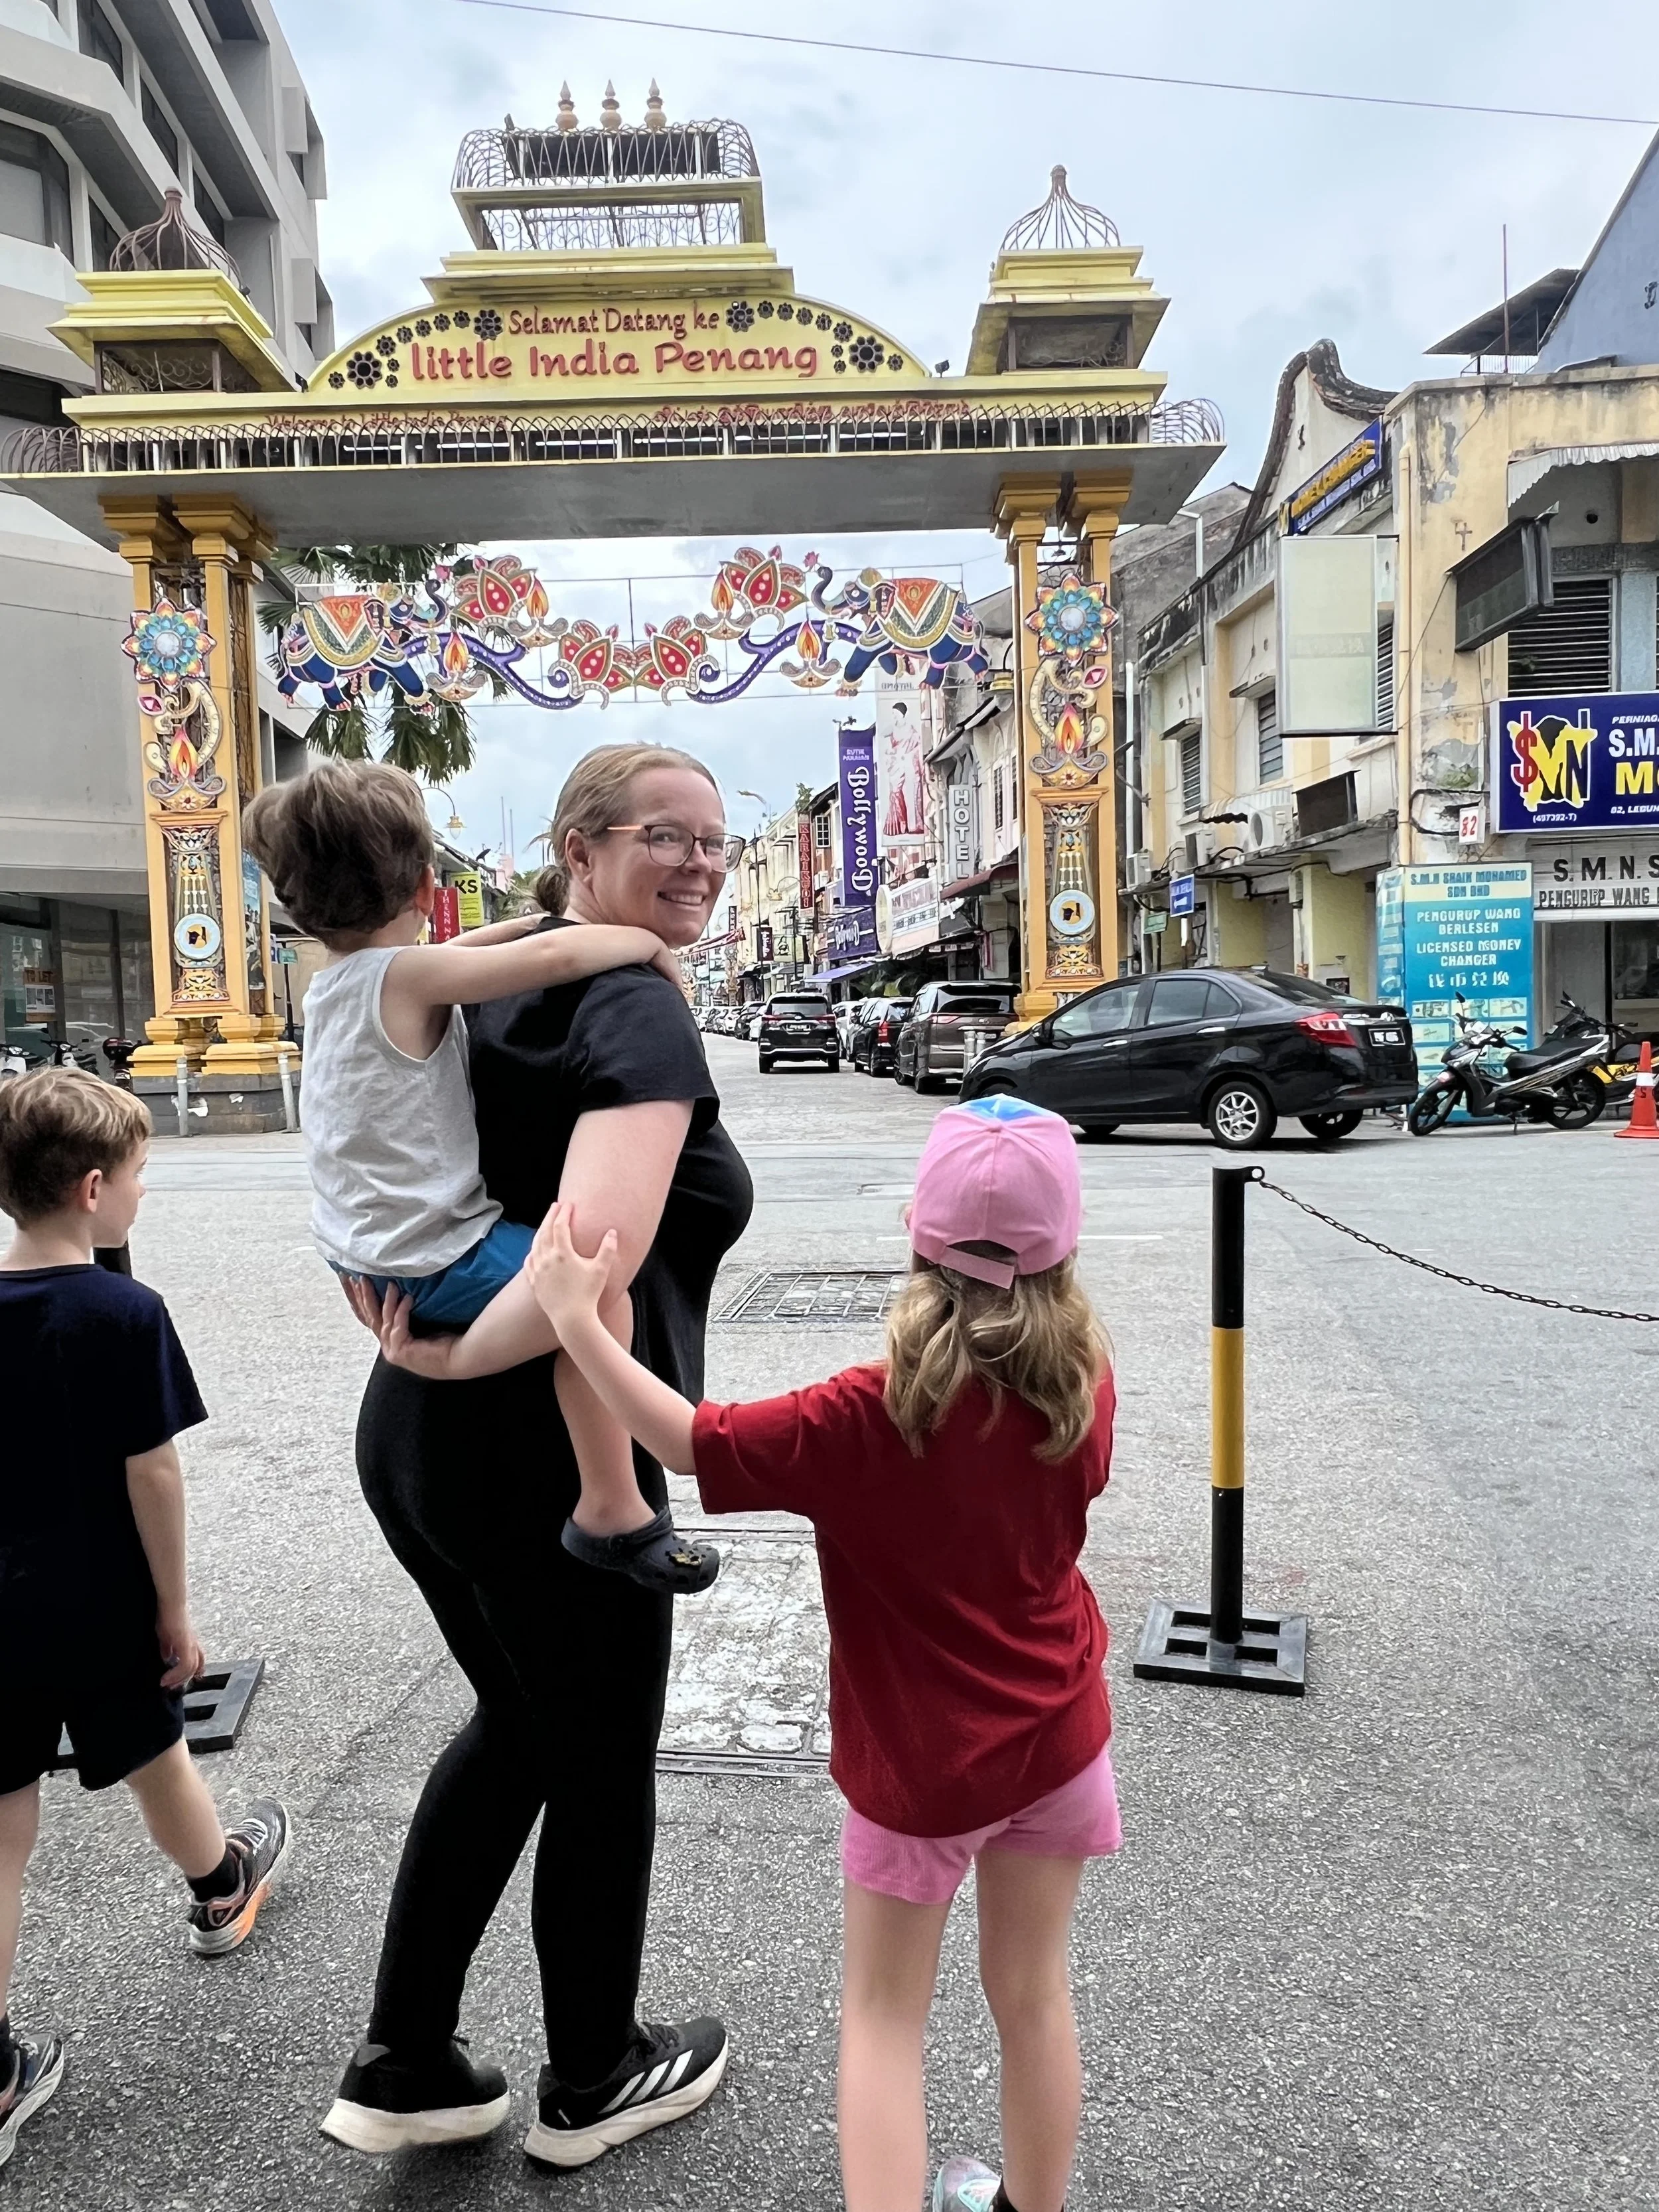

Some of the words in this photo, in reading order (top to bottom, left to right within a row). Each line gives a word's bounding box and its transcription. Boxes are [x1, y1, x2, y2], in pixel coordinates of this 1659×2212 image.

[508, 306, 599, 334] Selamat
[603, 307, 687, 340] Datang
[693, 299, 720, 330] ke
[530, 338, 640, 377] India
[654, 341, 817, 378] Penang
[1616, 761, 1659, 795] M
[954, 789, 970, 880] HOTEL
[1461, 816, 1477, 837] 82
[1476, 870, 1527, 883] MOHAMED
[1612, 887, 1650, 906] WANG
[1417, 909, 1480, 922] PENGURUP
[1485, 908, 1521, 920] WANG
[1439, 922, 1498, 935] BERLESEN
[1416, 940, 1473, 954] LICENSED
[1479, 939, 1522, 951] MONEY
[1441, 954, 1496, 967] CHANGER
